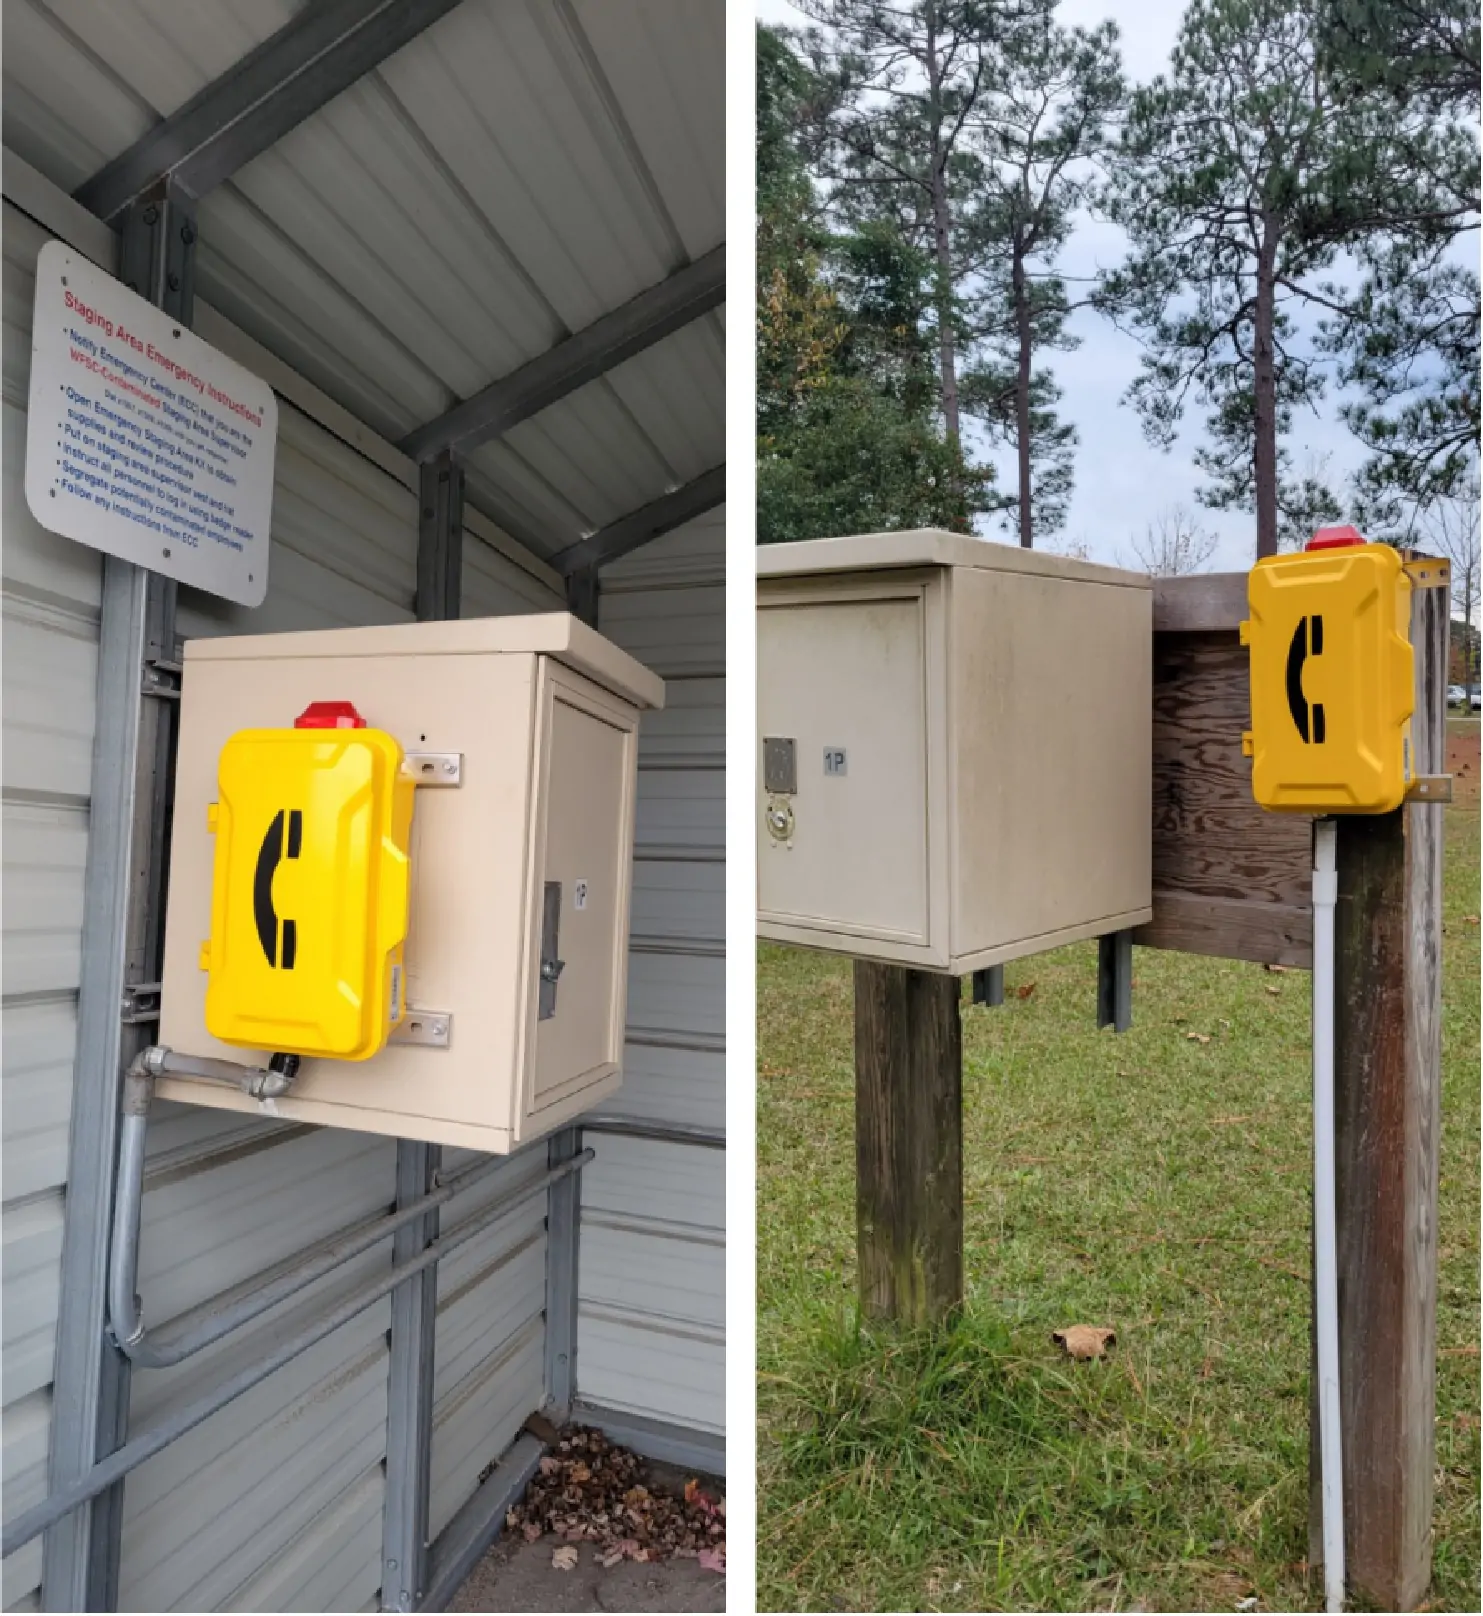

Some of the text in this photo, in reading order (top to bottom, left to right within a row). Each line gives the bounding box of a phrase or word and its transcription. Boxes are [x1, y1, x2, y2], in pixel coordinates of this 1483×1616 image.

[65, 290, 113, 337] Staging
[116, 325, 144, 353] Area
[146, 342, 205, 395] Emergency
[207, 382, 262, 428] Instructions
[69, 328, 252, 448] Notify Emergency Center (ECC) that you are the
[65, 386, 91, 410] Open
[94, 401, 142, 438] Emergency
[144, 429, 175, 455] Staging
[175, 446, 193, 464] Area
[215, 469, 237, 487] obtain
[65, 423, 81, 441] Put
[82, 434, 96, 447] on
[97, 441, 130, 468] staging
[130, 459, 151, 476] area
[151, 468, 192, 496] supervisor
[208, 498, 223, 511] and
[67, 408, 106, 436] supplies
[109, 429, 125, 445] and
[127, 439, 154, 460] review
[162, 401, 191, 430] Staging
[192, 420, 209, 437] Area
[210, 429, 247, 460] Supervisor
[61, 478, 199, 549] Follow any instructions from ECC
[62, 459, 109, 491] Segregate
[110, 484, 154, 514] potentially
[155, 505, 206, 535] contaminated
[63, 442, 99, 468] Instruct
[100, 461, 112, 475] all
[113, 468, 156, 494] personnel
[157, 487, 166, 499] to
[166, 492, 179, 508] log
[188, 504, 209, 522] using
[210, 513, 232, 532] badge
[825, 752, 845, 772] 1P
